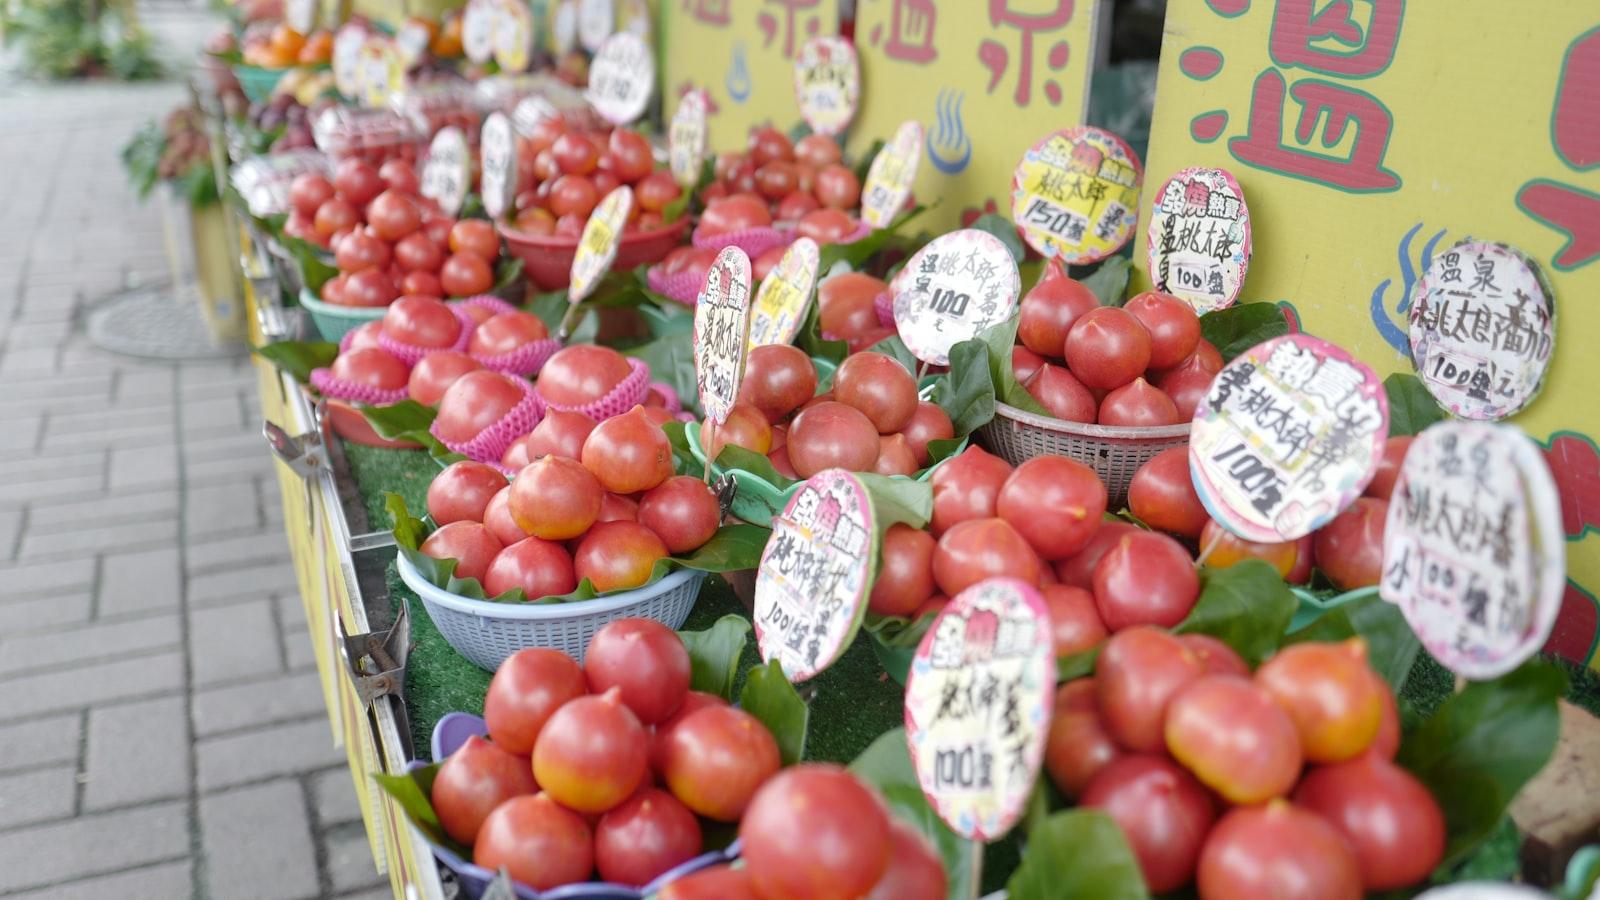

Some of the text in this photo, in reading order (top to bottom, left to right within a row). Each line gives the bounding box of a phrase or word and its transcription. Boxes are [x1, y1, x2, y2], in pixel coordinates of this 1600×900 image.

[1162, 178, 1241, 221] 發燒熱賣
[1440, 252, 1502, 292] 溫泉
[929, 288, 970, 316] 100
